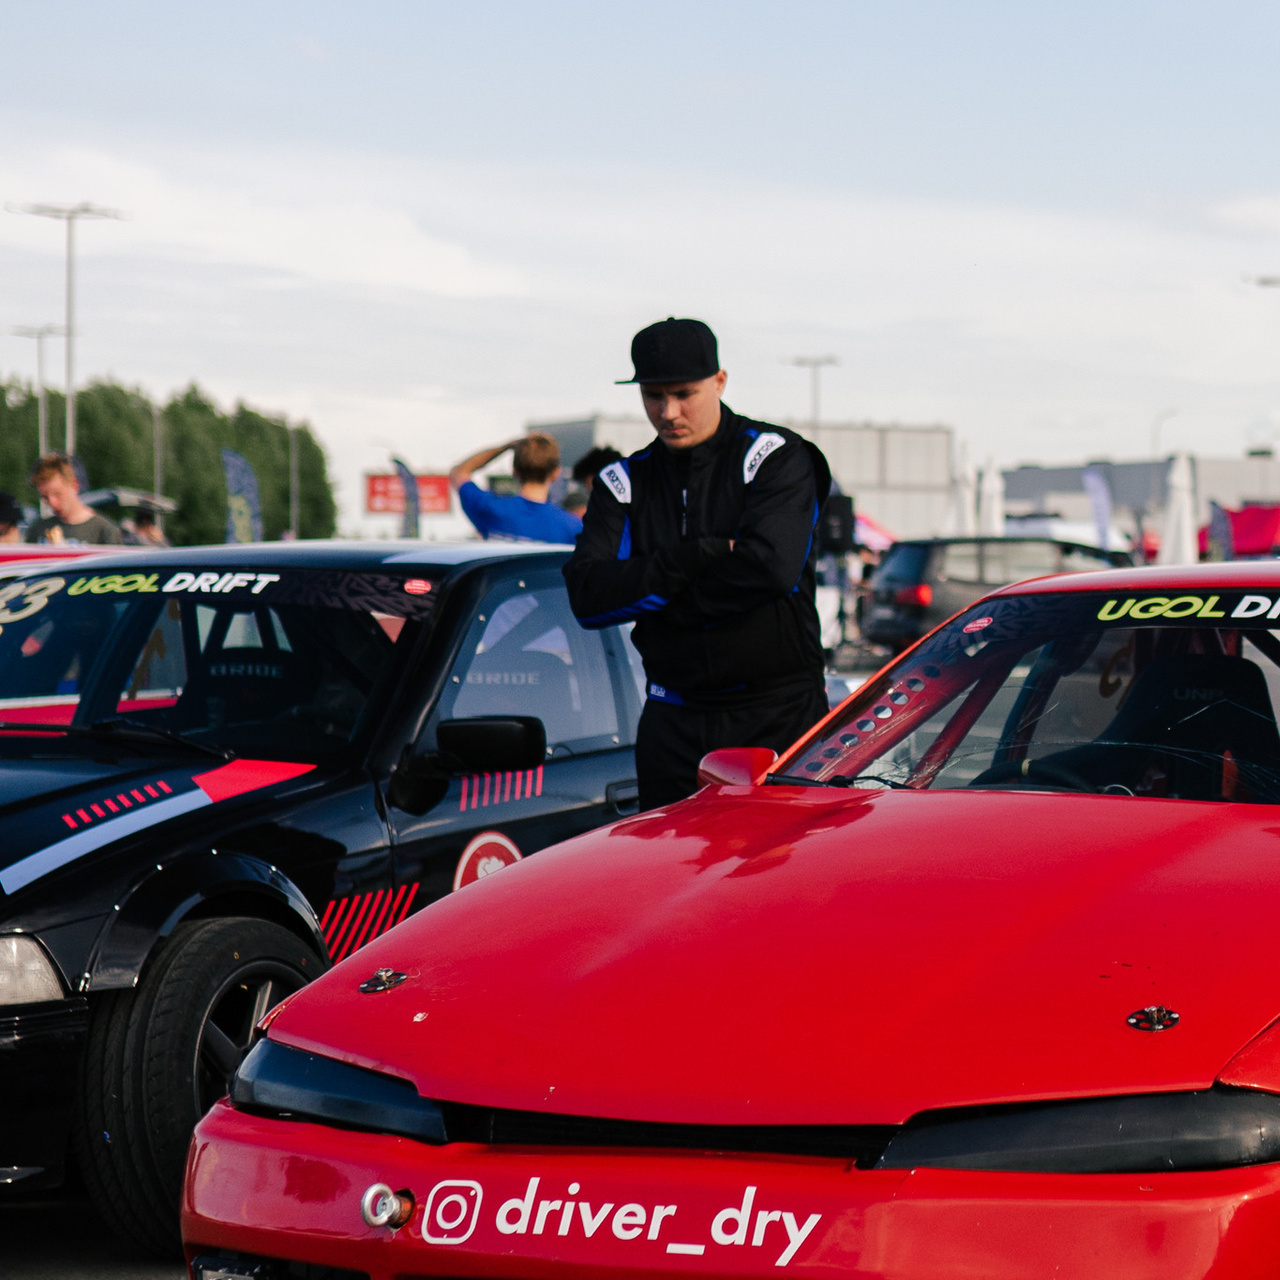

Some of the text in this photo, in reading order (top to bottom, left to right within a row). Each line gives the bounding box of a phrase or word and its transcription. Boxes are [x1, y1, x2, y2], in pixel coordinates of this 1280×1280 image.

[67, 572, 280, 596] UGOL DRIFT
[1096, 595, 1226, 621] UGOL
[466, 672, 541, 685] BRIDE
[495, 1176, 822, 1268] driver_dry
